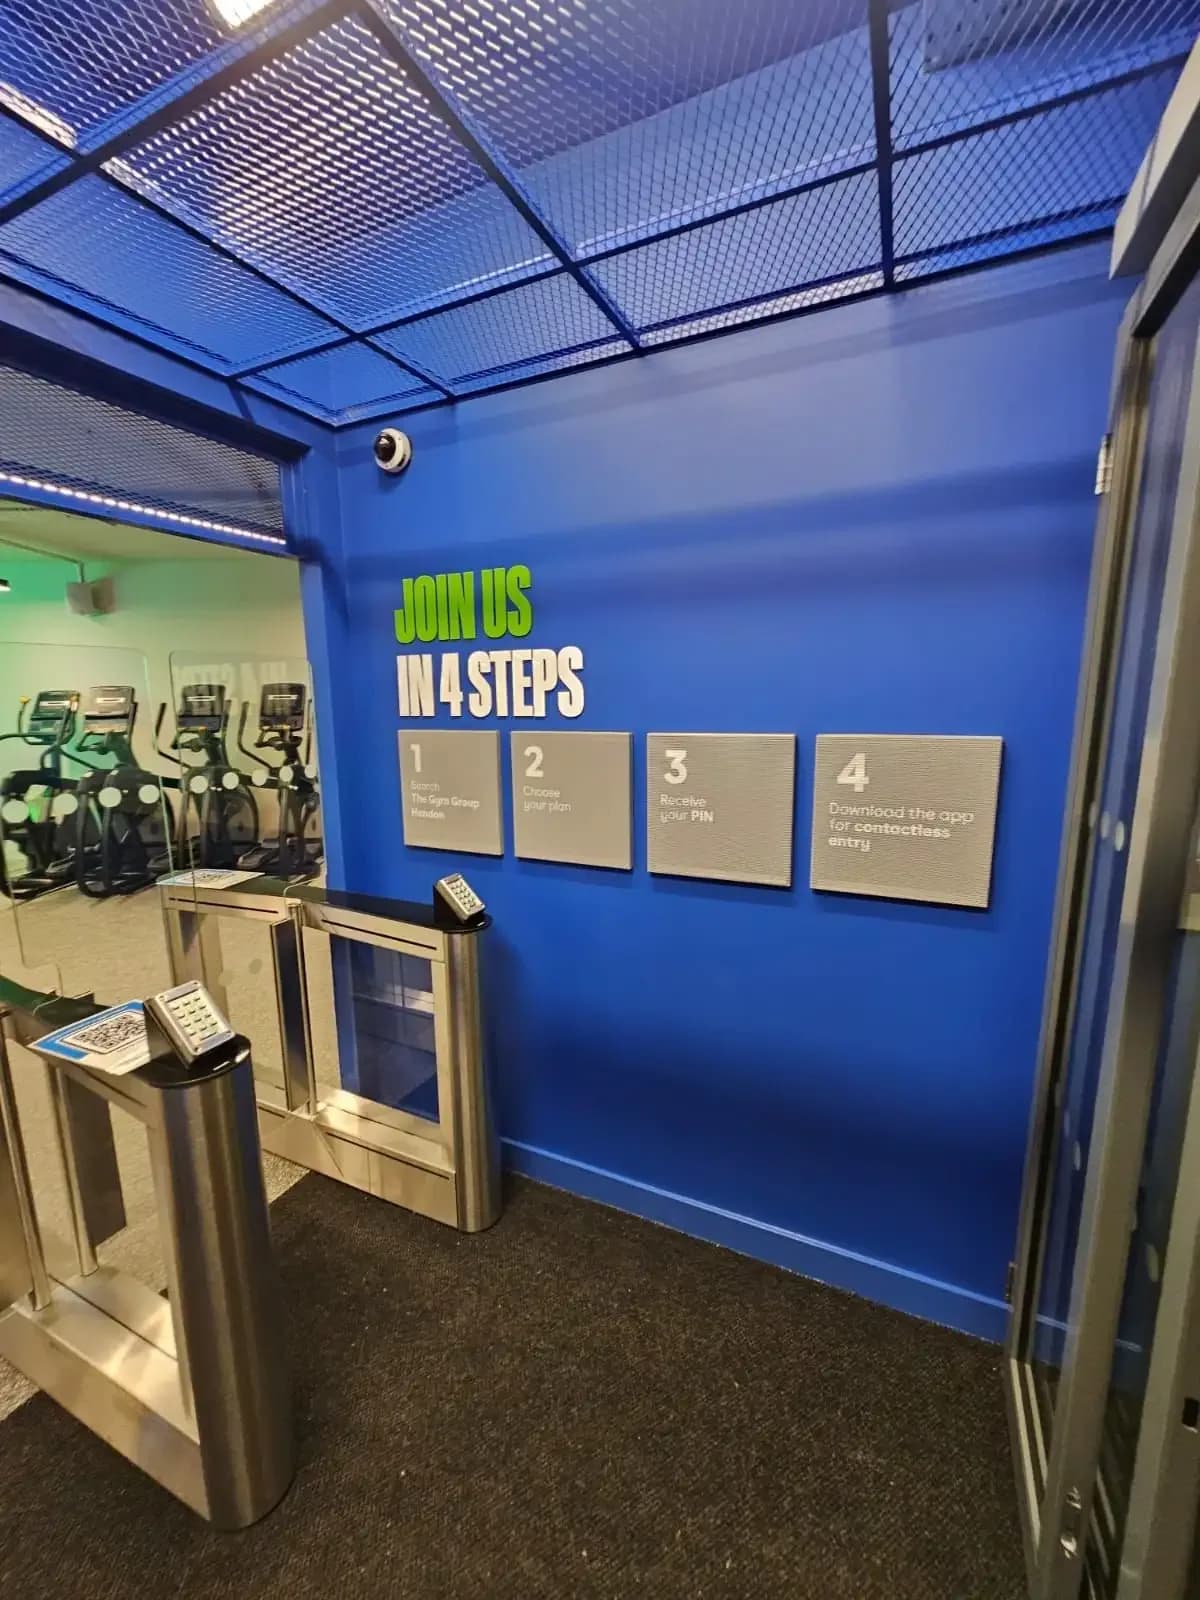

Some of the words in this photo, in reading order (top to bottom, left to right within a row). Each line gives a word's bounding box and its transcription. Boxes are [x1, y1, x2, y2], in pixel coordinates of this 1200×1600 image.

[394, 571, 476, 644] JOIN
[481, 564, 532, 639] US
[396, 654, 435, 717] IN
[440, 652, 463, 717] 4
[467, 646, 585, 718] STEPS
[410, 743, 422, 773] 1
[524, 746, 544, 777] 2
[664, 749, 687, 785] 3
[837, 753, 870, 792] 4
[411, 792, 428, 804] The
[450, 796, 481, 811] Group
[523, 785, 561, 799] Choose
[660, 793, 707, 808] Receive
[523, 799, 547, 812] your
[548, 800, 572, 815] plan
[660, 810, 690, 824] your
[691, 810, 714, 823] PIN
[829, 802, 906, 819] Download
[908, 807, 936, 821] the
[938, 810, 975, 825] app
[830, 818, 852, 832] for
[854, 822, 951, 839] contactless
[828, 836, 870, 852] entry
